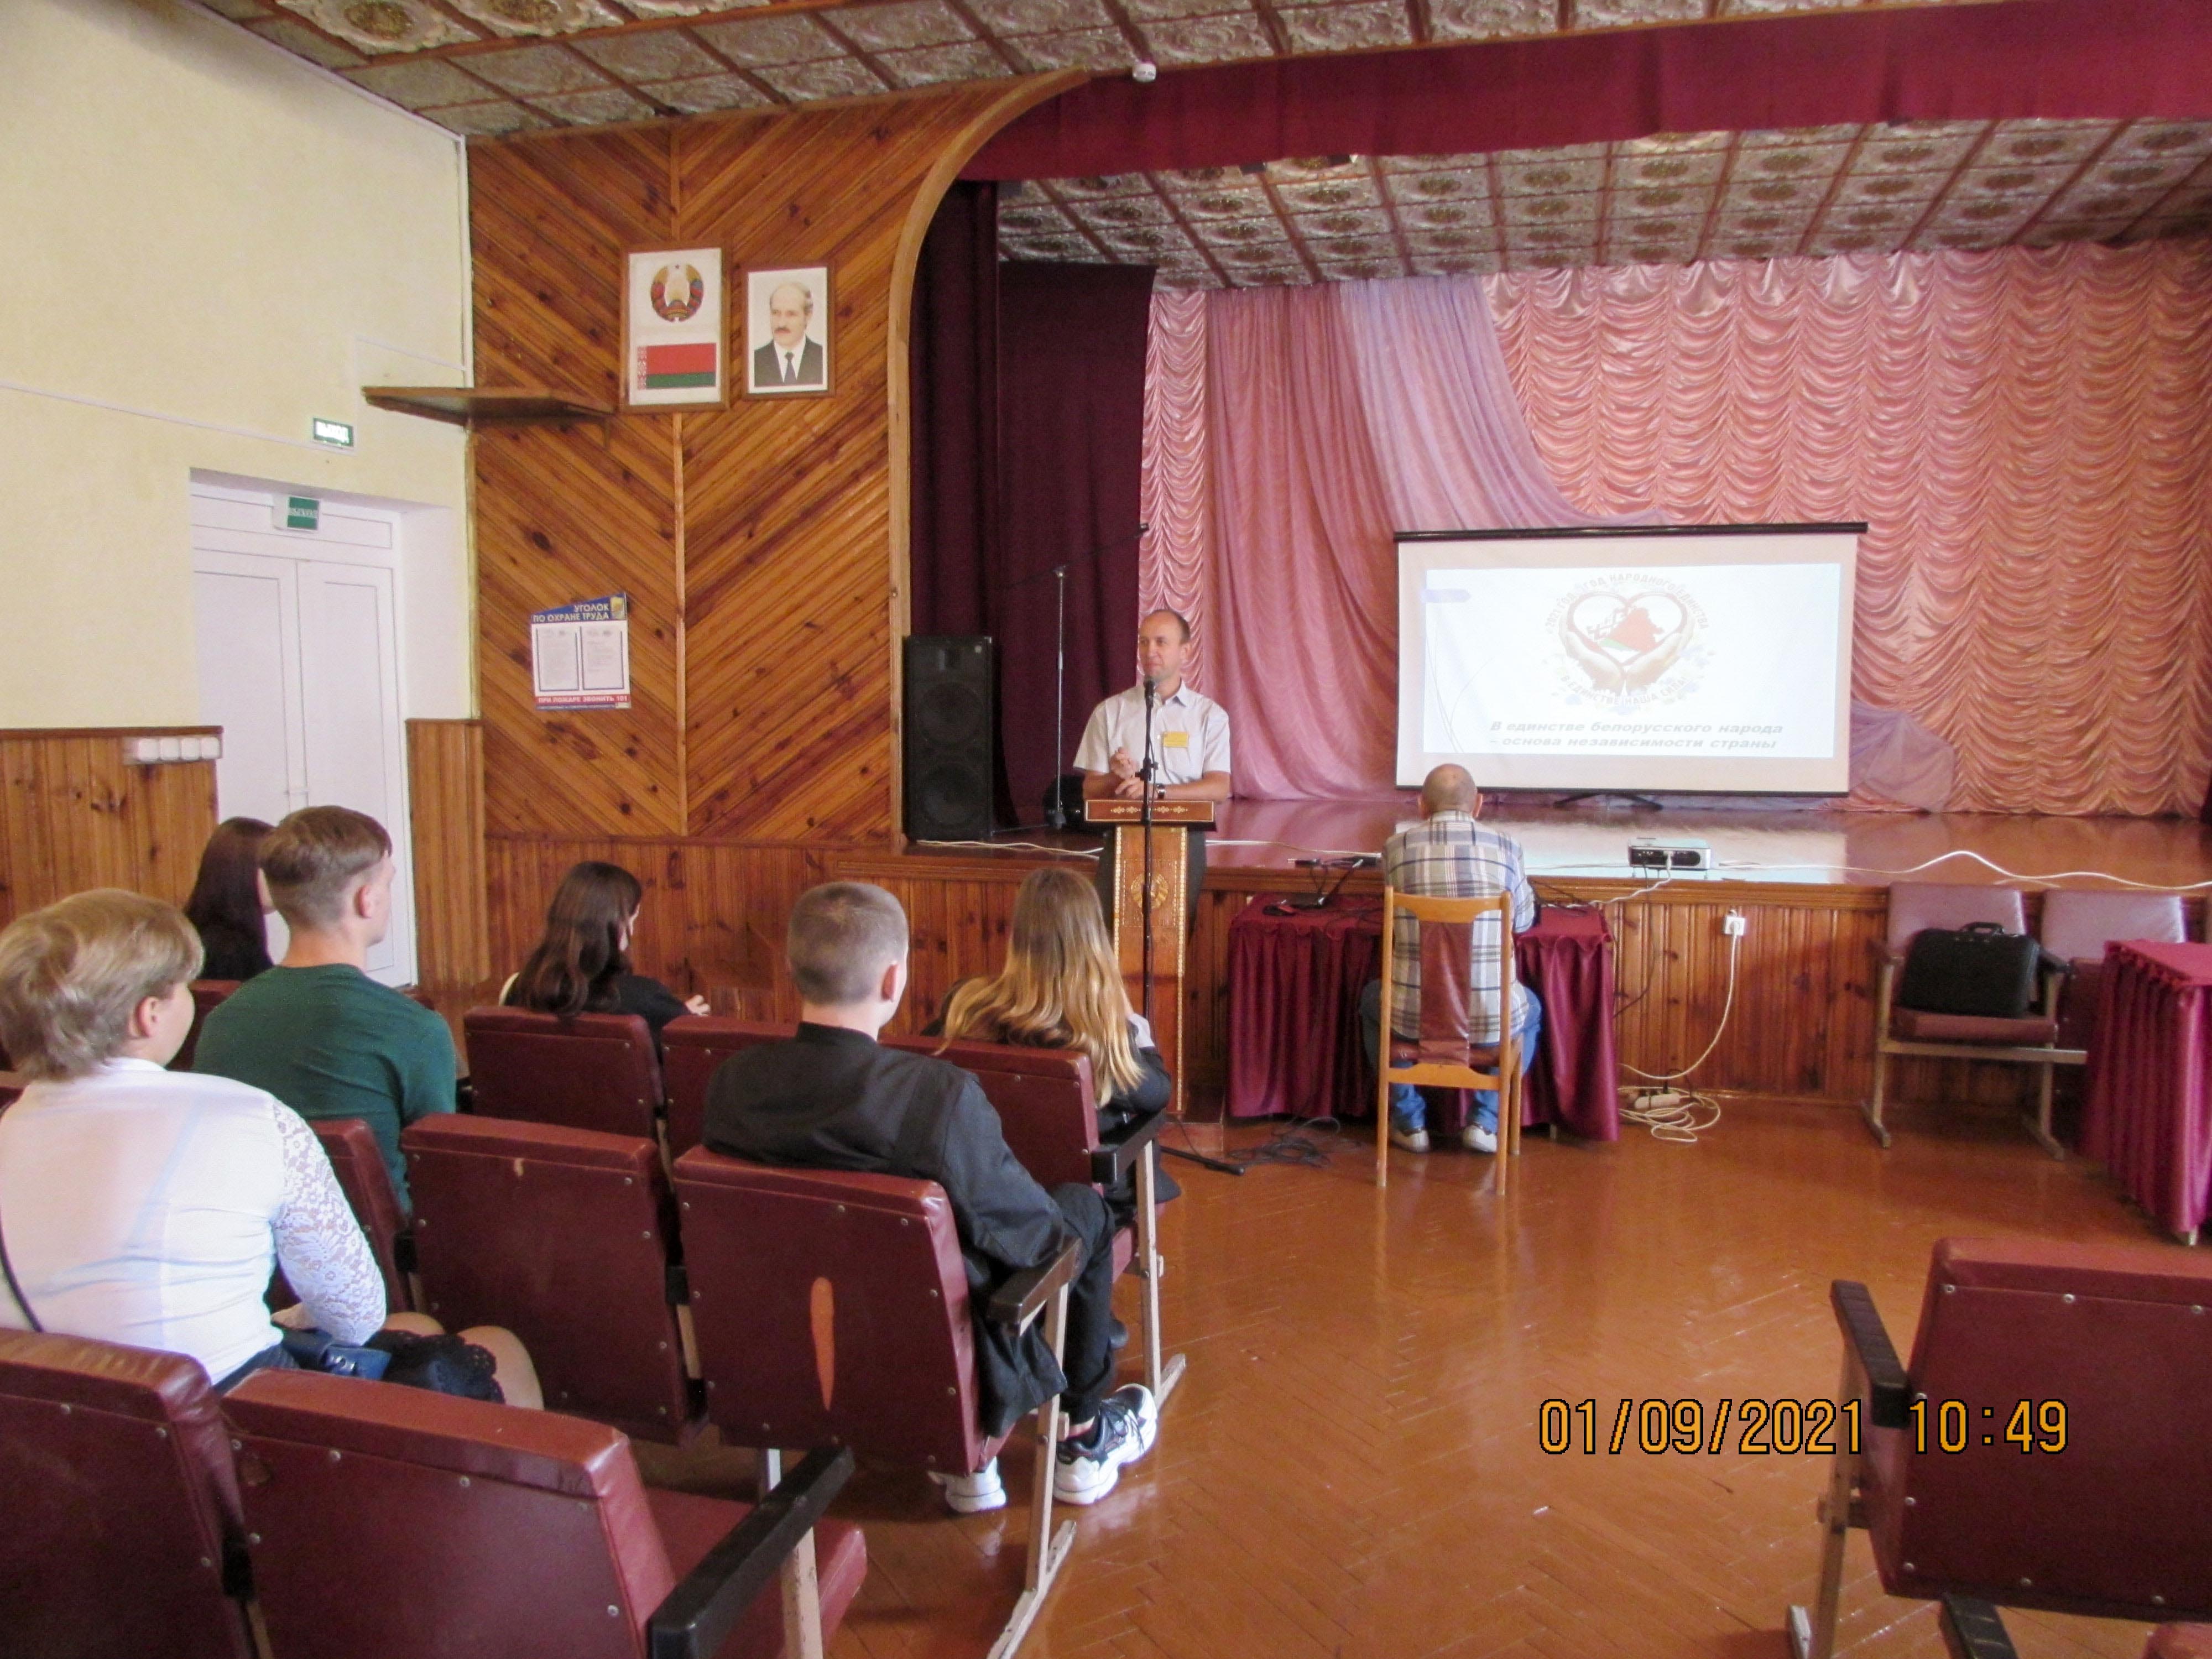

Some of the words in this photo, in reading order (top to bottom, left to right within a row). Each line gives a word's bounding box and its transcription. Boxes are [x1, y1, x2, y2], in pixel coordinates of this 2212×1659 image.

[574, 603, 609, 612] УГОЛОК
[1583, 577, 1606, 589] ГОД
[1609, 573, 1676, 591] НАРОДНОГО
[1676, 588, 1709, 630] ЕДИНСТВА
[547, 613, 580, 622] ОХРАНЕ
[582, 612, 609, 620] ТРУДА
[1490, 721, 1502, 732] В
[1506, 723, 1585, 732] единстве
[1590, 721, 1712, 734] белорусского
[1718, 724, 1783, 735] народа
[1502, 738, 1562, 746] основа
[1567, 738, 1703, 748] независимости
[1710, 739, 1777, 750] страны
